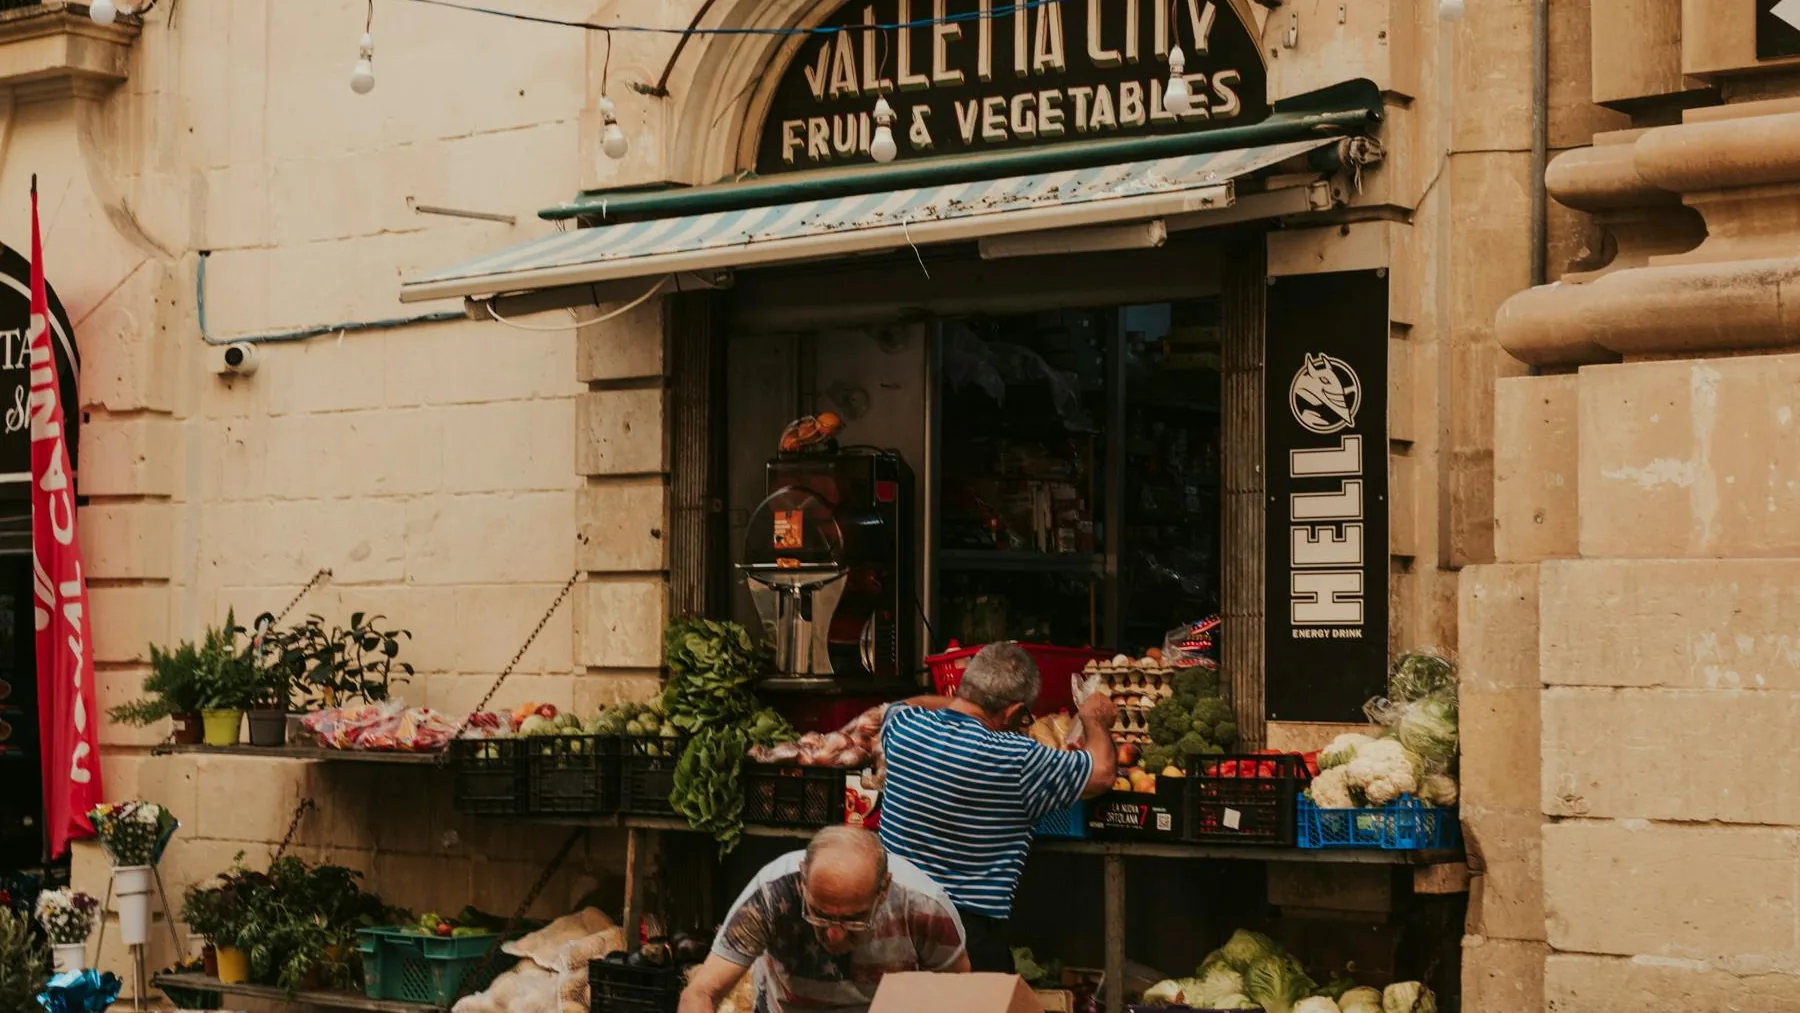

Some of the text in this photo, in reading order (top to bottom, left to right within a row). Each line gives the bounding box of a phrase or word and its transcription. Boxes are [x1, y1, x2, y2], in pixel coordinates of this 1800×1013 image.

[782, 69, 1241, 165] FRUI & VEGETABLES
[1290, 434, 1364, 625] HELL
[1292, 628, 1362, 639] ENERGY DRINK
